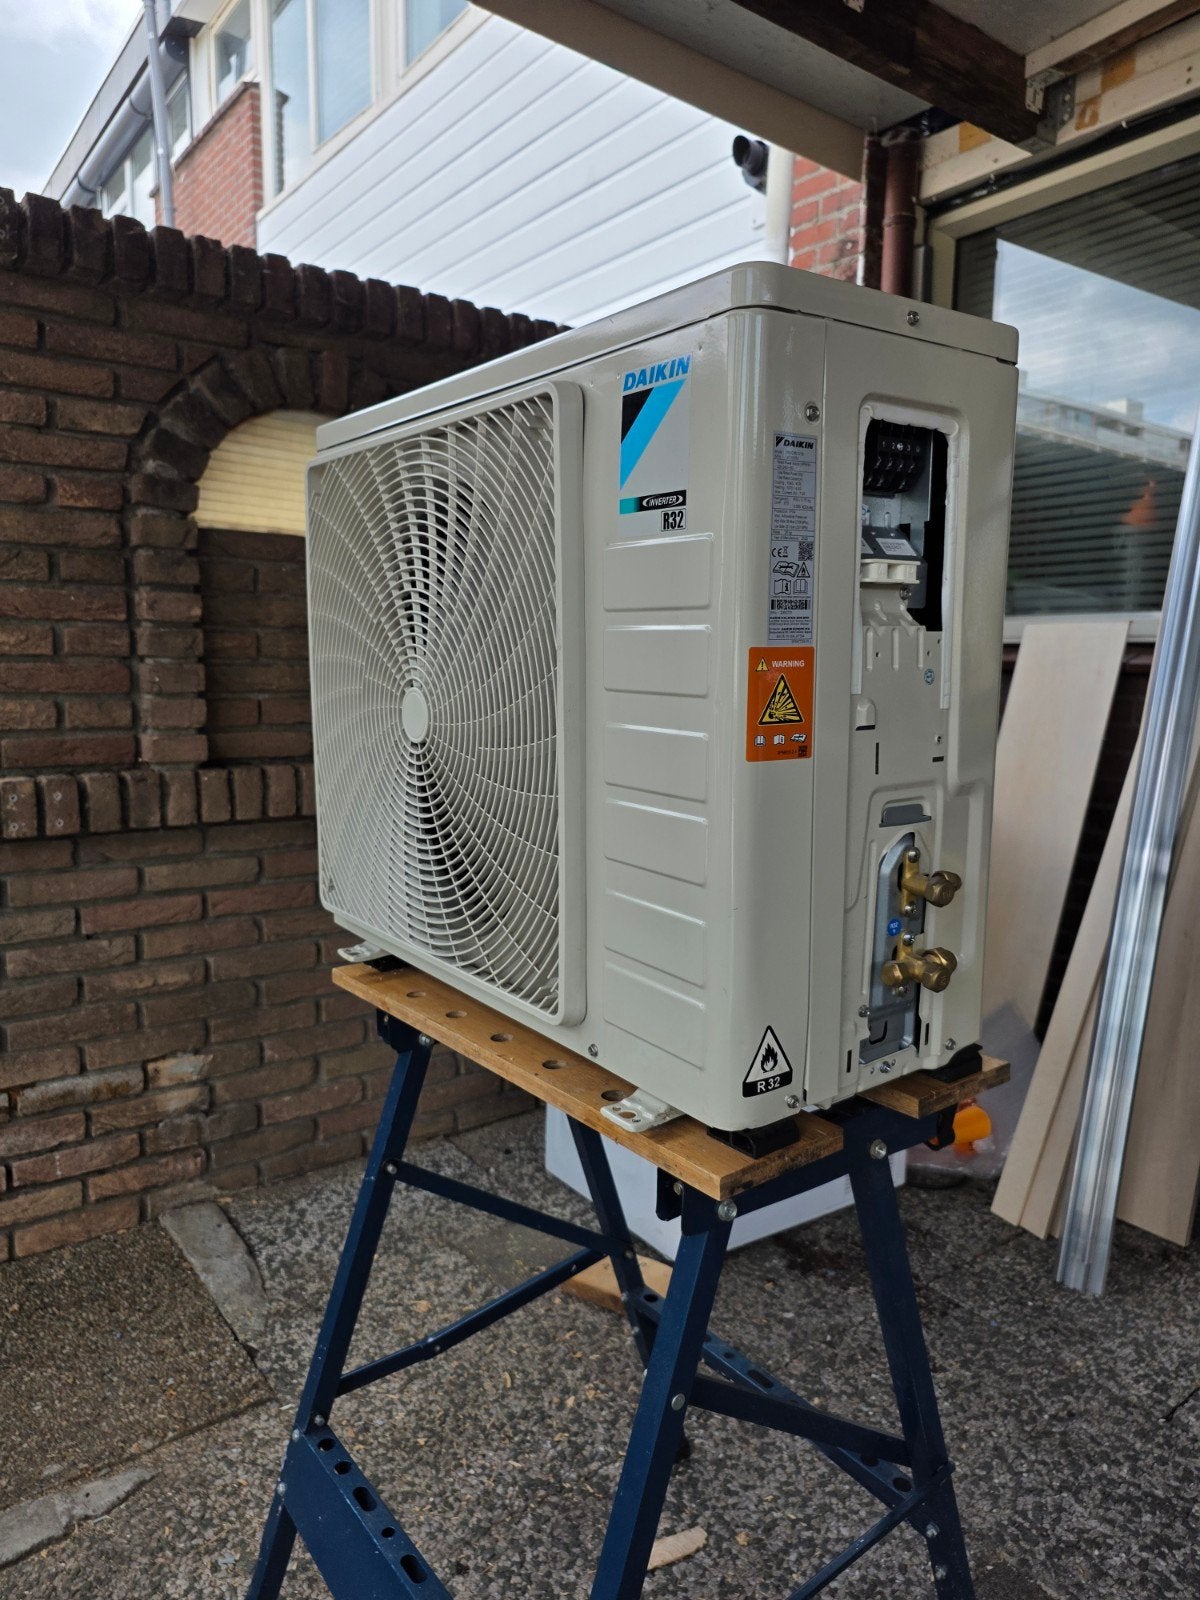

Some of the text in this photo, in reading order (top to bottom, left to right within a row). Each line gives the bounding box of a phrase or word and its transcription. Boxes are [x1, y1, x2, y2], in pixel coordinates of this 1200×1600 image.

[623, 355, 692, 392] DAIKIN
[783, 439, 814, 450] DAIKIN
[648, 495, 677, 507] INVERTER
[663, 510, 684, 530] R32
[771, 659, 805, 668] WARNING
